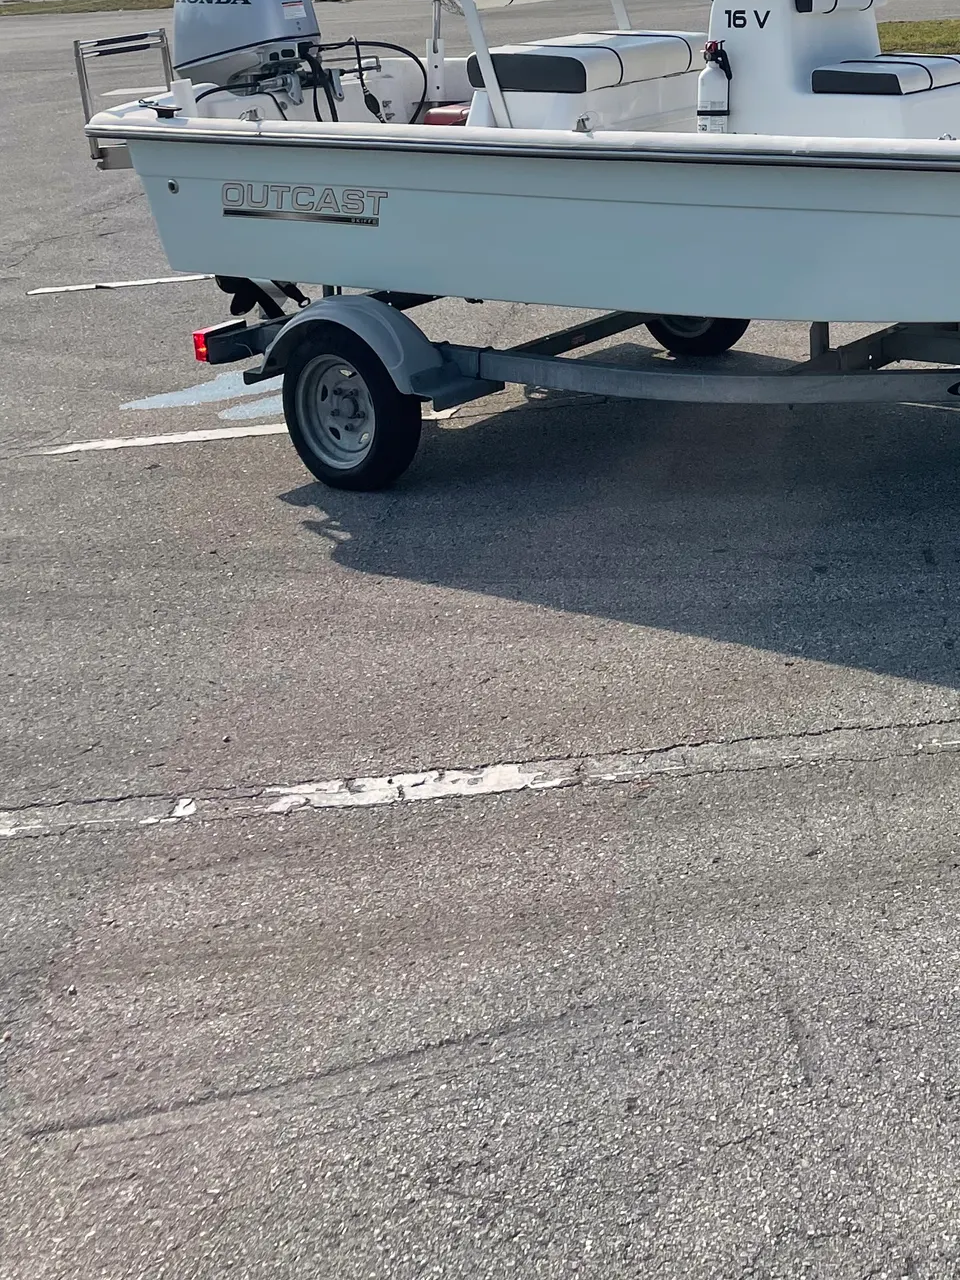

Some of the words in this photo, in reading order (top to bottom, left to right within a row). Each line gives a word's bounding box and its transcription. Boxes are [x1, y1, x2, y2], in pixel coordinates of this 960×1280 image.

[724, 9, 747, 29] 16
[753, 9, 771, 29] V
[221, 182, 389, 216] OUTCAST
